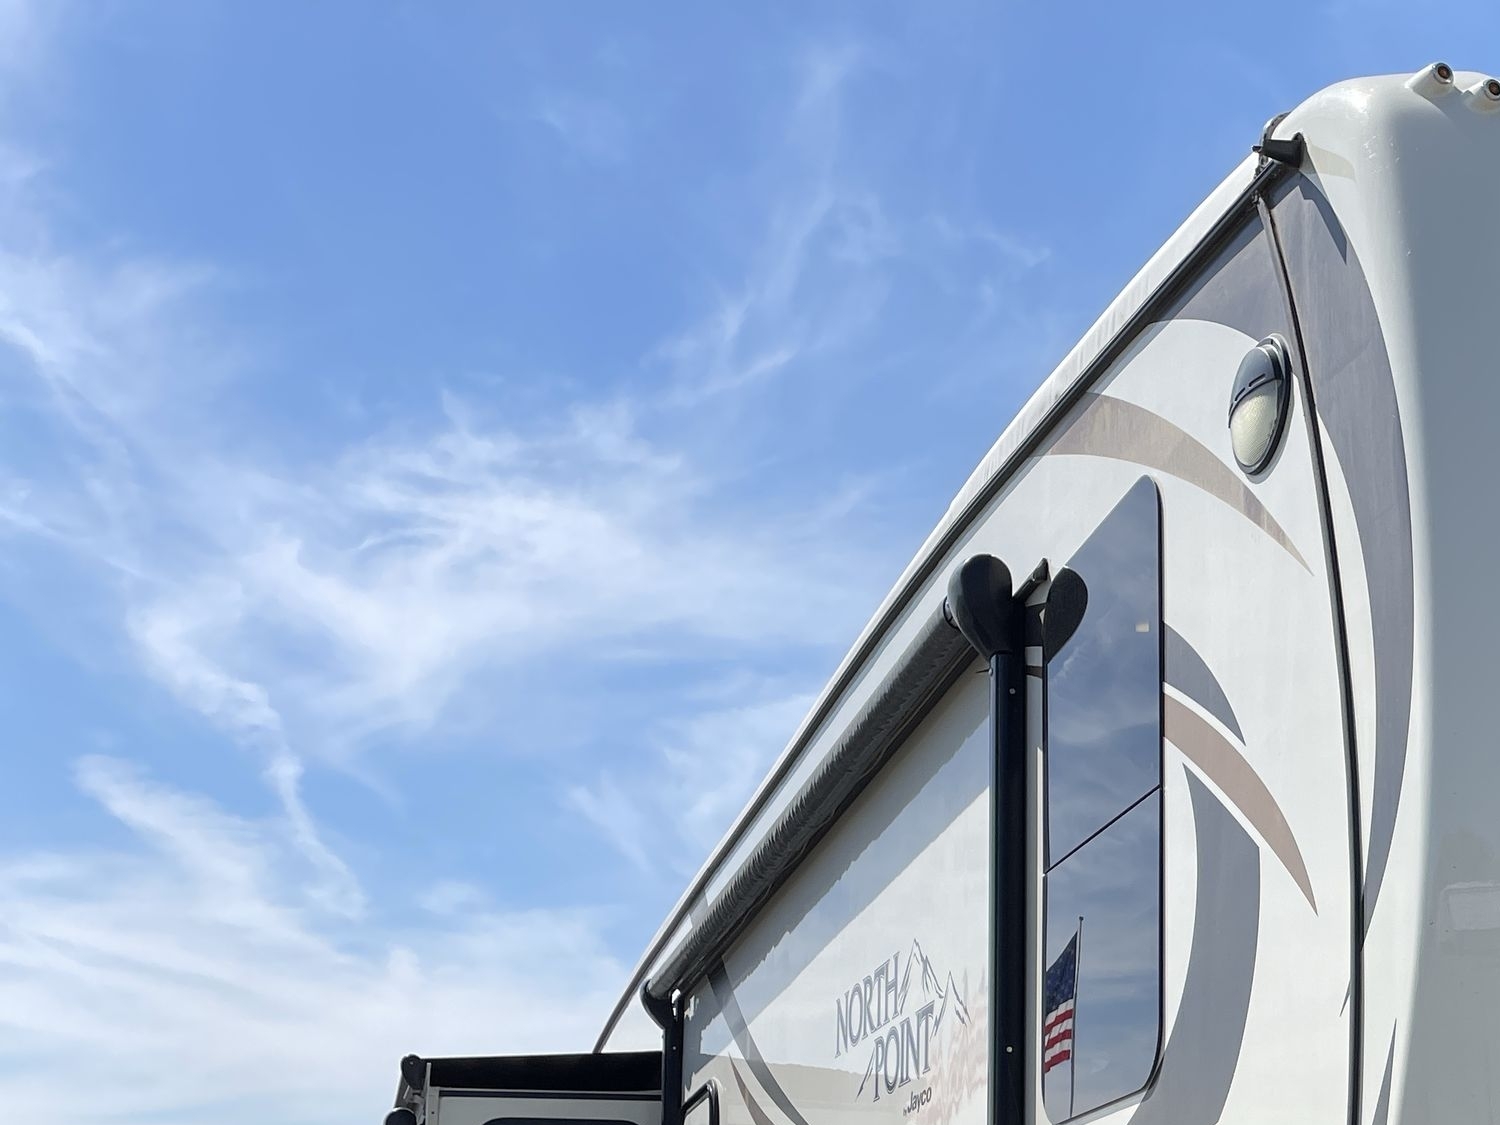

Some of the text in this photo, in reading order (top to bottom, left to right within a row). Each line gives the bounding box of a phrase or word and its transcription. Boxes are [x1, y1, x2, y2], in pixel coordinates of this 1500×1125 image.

[834, 950, 901, 1060] NORTH
[872, 999, 936, 1103] POINT
[907, 1086, 932, 1114] Jayco
